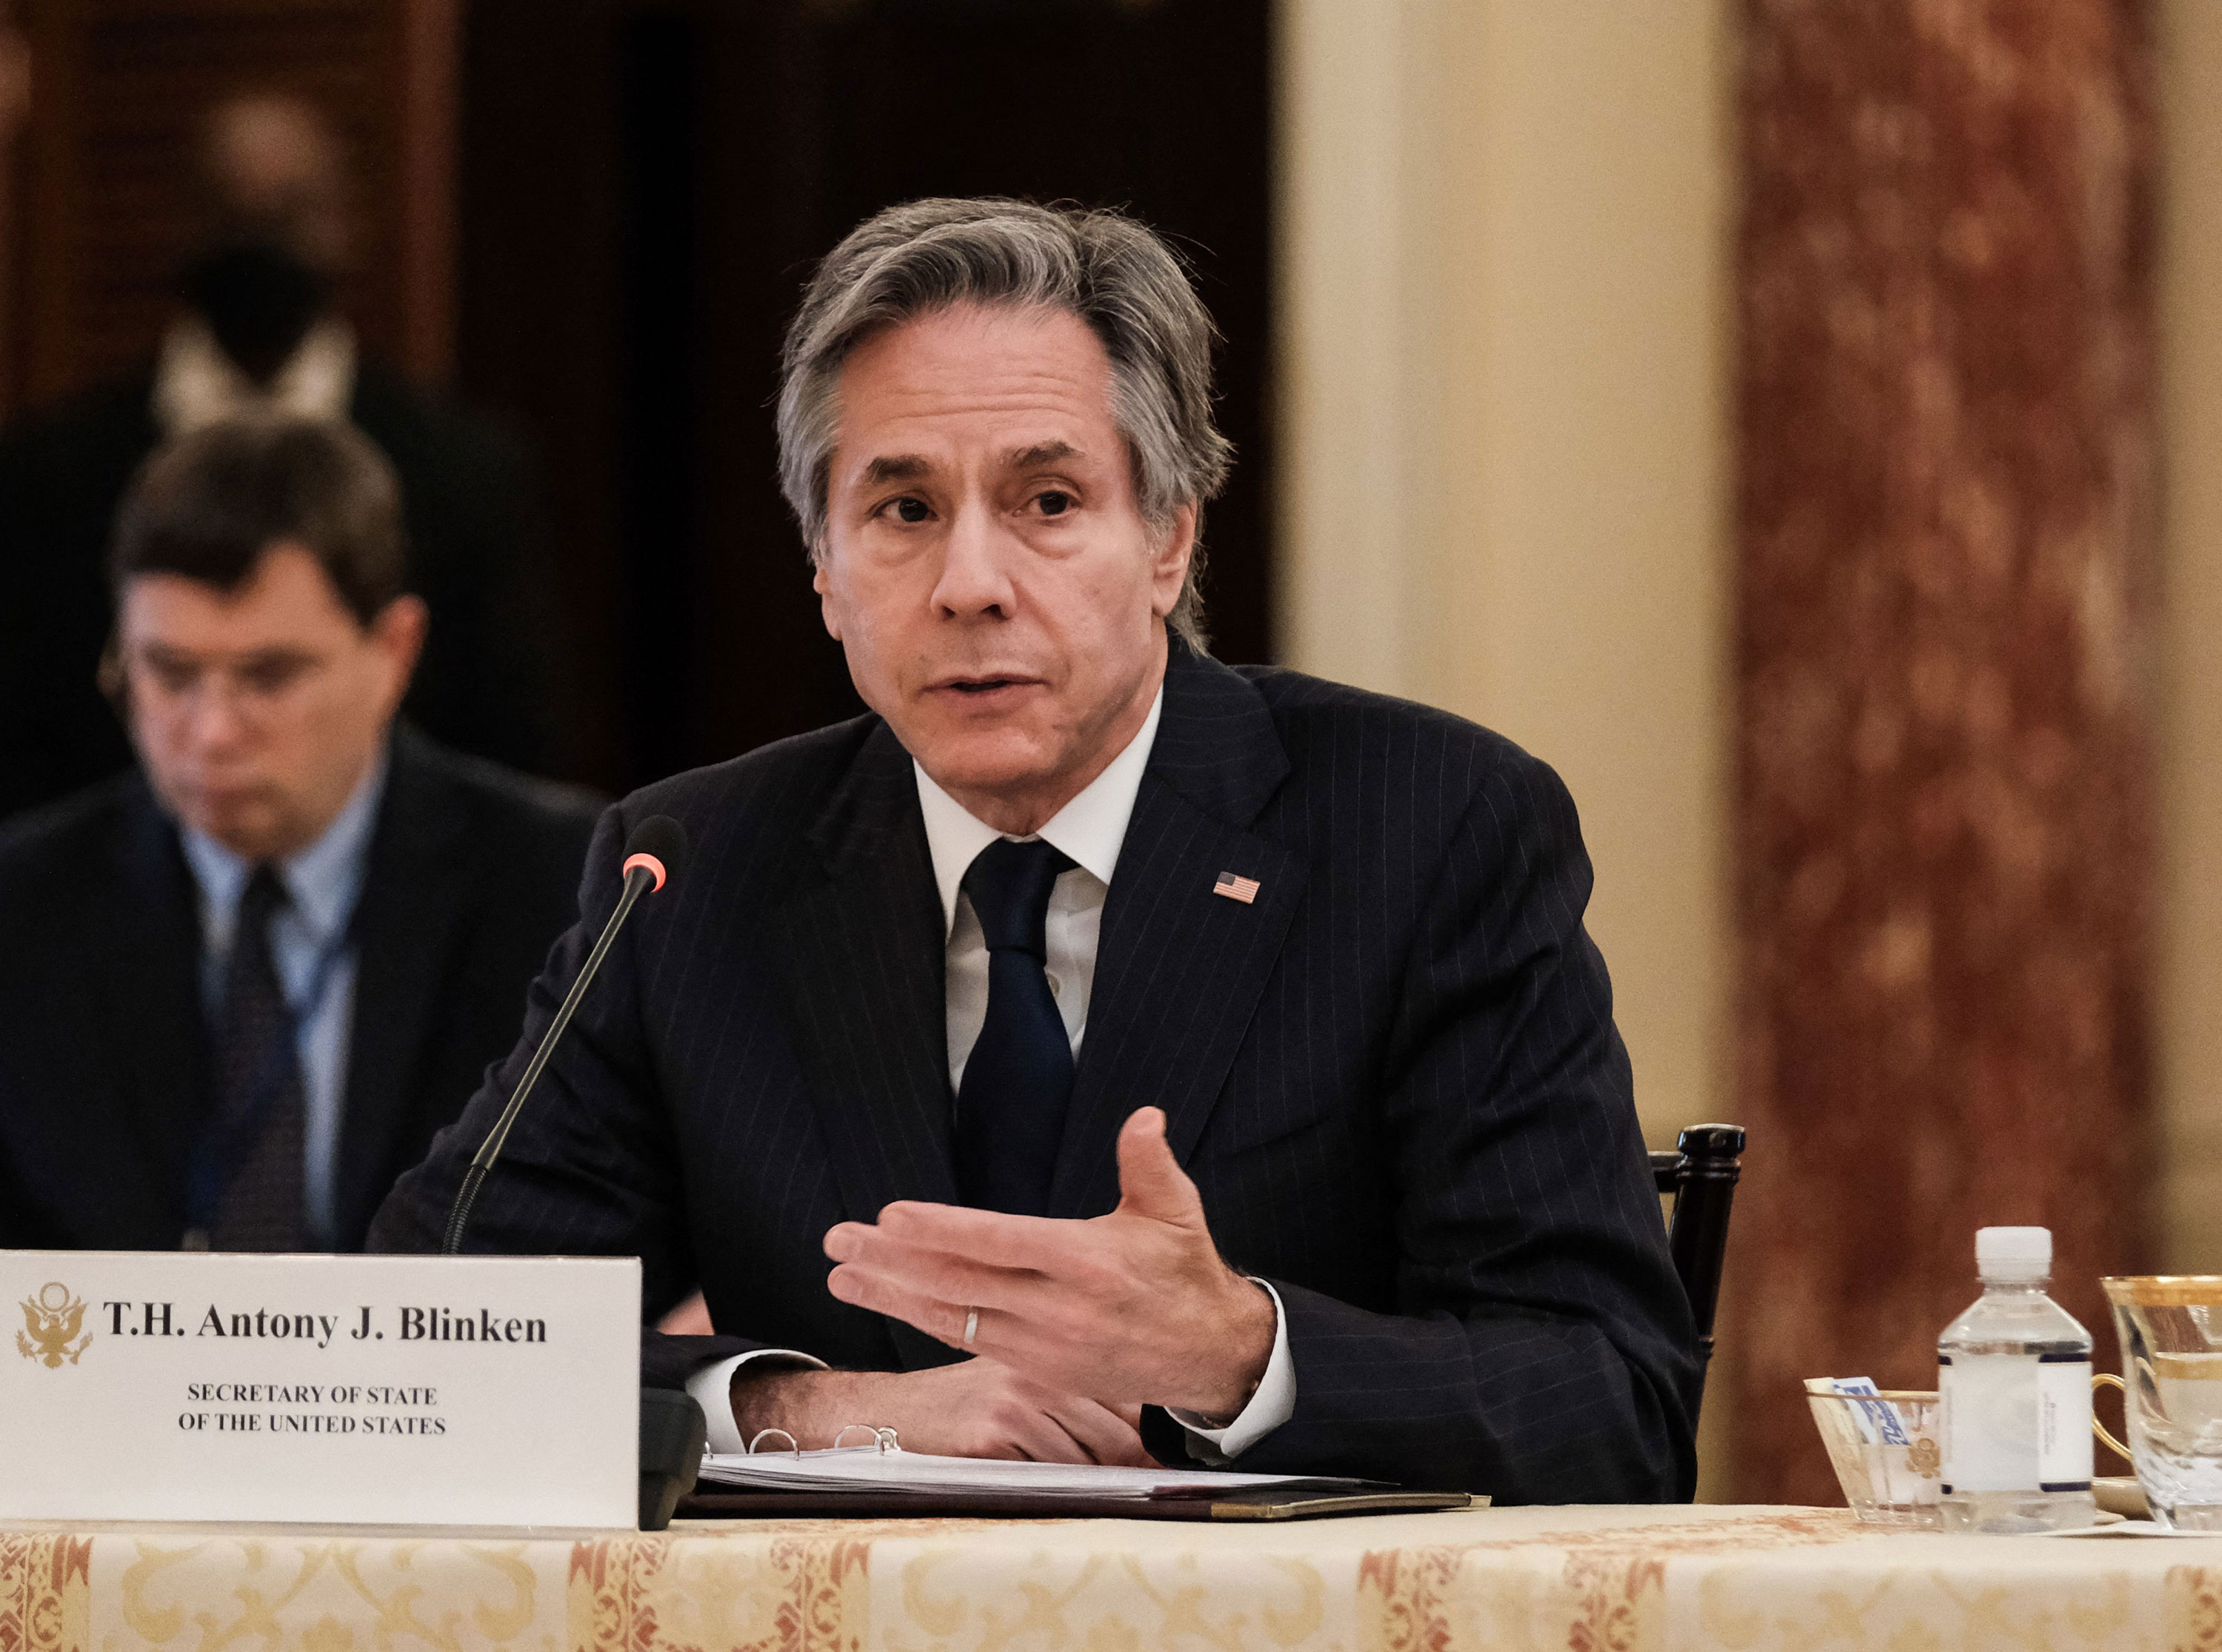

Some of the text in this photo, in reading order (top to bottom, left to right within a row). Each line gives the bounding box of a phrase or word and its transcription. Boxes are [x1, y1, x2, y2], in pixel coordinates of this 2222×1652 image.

[103, 1301, 547, 1349] T.H. Antony J. Blinken
[187, 1383, 438, 1406] SECRETARY OF STATE
[178, 1413, 447, 1435] OF THE UNITED STATES
